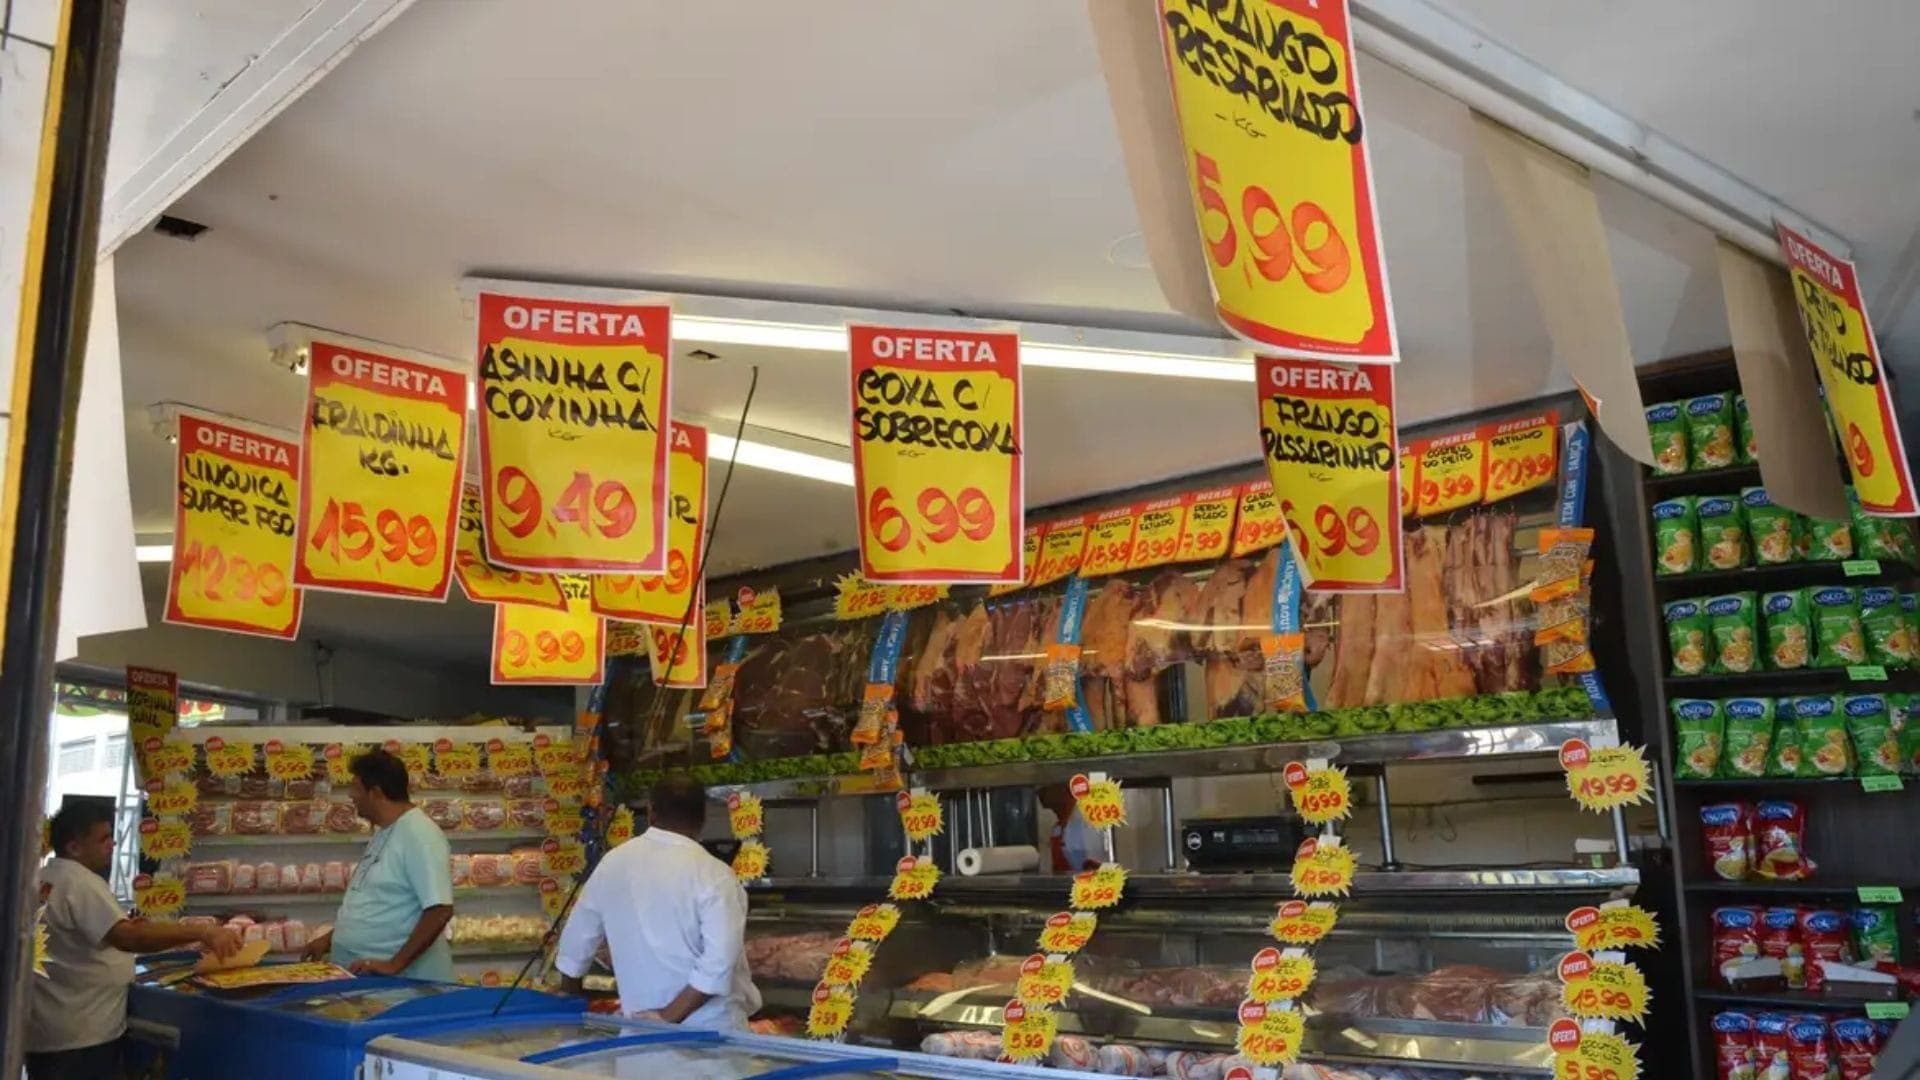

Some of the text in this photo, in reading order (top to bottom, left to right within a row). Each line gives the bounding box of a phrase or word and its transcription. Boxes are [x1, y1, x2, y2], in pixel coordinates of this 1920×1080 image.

[1165, 10, 1363, 144] RESFRIADO
[1788, 237, 1844, 291] OFERTA
[503, 305, 645, 337] OFERTA
[480, 343, 651, 395] ASINHA C/
[871, 335, 997, 363] OFERTA
[330, 354, 448, 397] OFERTA
[858, 368, 945, 410] COXA
[1270, 366, 1373, 392] OFERTA
[312, 395, 455, 461] FRALDINHA
[485, 386, 658, 434] COXINHA
[853, 407, 1023, 456] SOBRECOXA
[1272, 396, 1380, 440] FRANGO
[196, 426, 290, 467] OFERTA
[1260, 427, 1396, 472] PASSARINHO
[180, 481, 250, 526] SUPER
[497, 465, 637, 540] 9,49
[869, 485, 996, 556] 6,99
[310, 495, 438, 576] 15,99
